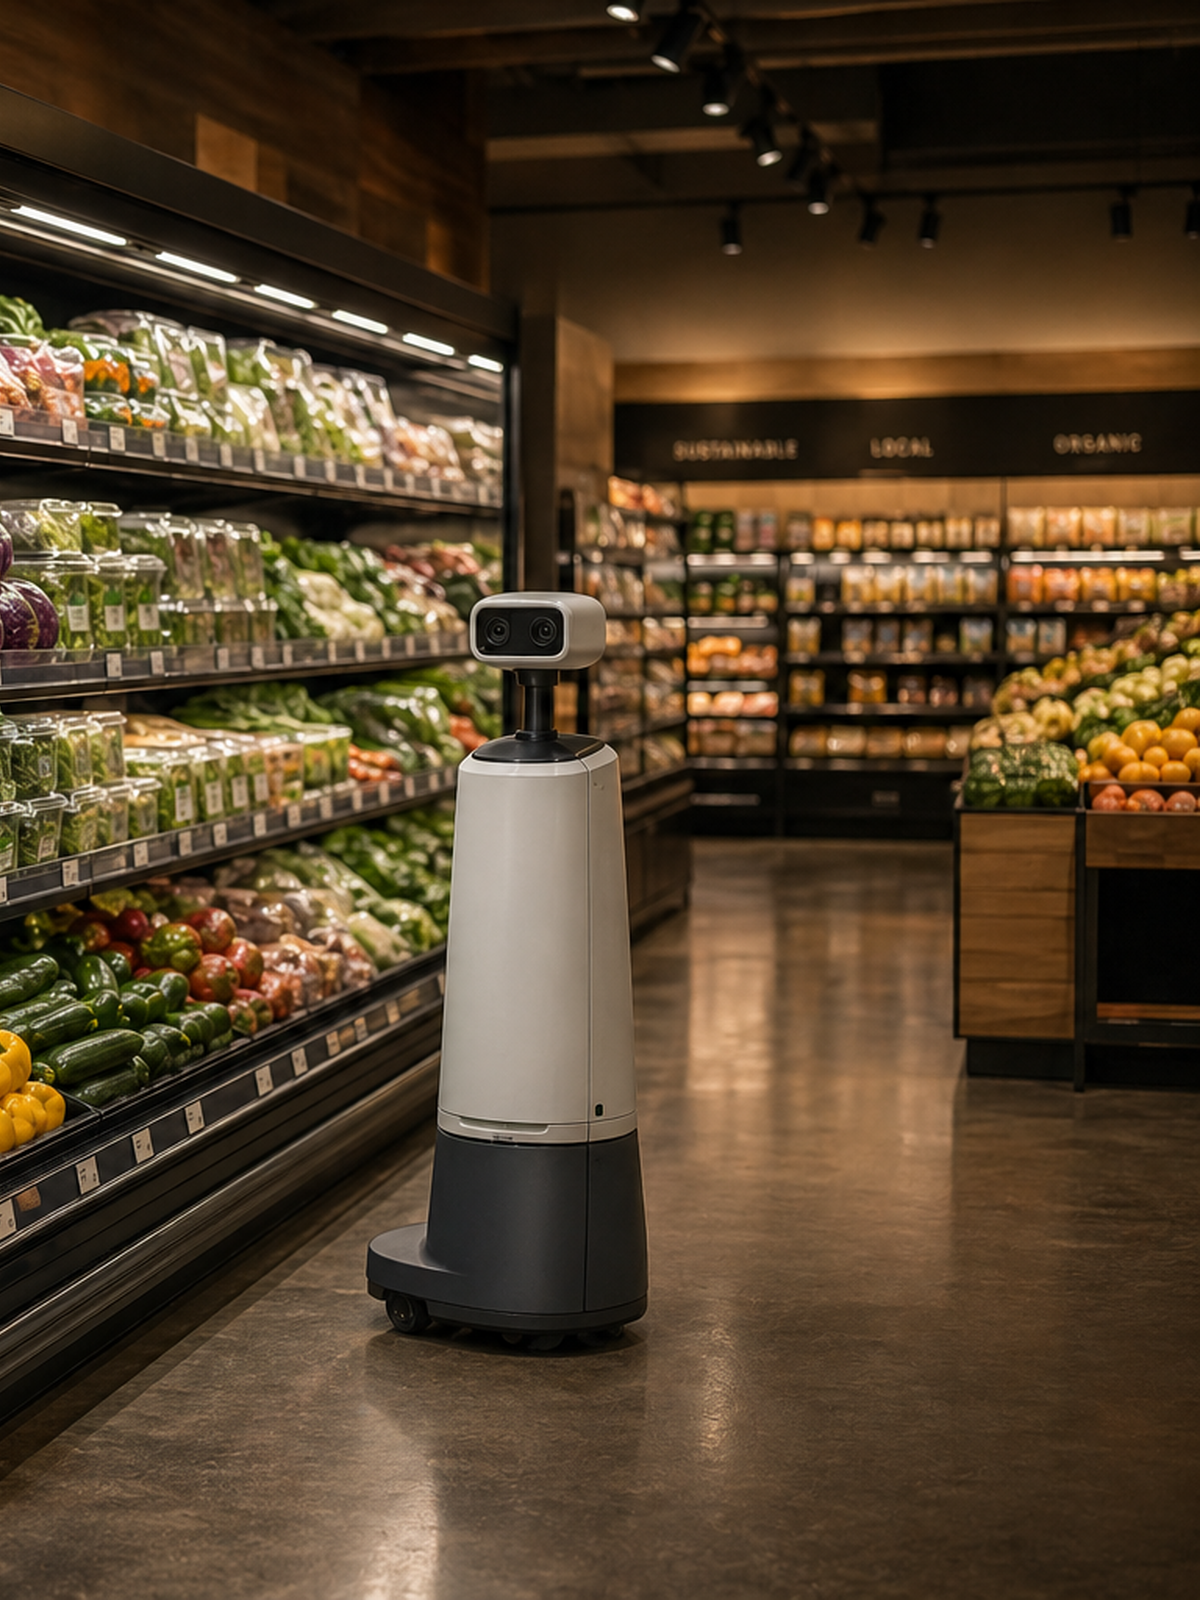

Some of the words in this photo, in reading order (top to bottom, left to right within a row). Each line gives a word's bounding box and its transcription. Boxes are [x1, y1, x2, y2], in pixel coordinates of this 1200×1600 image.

[673, 438, 798, 462] SUSTAINABLE
[870, 436, 934, 458] LOCAL
[1053, 432, 1142, 455] ORGANIC
